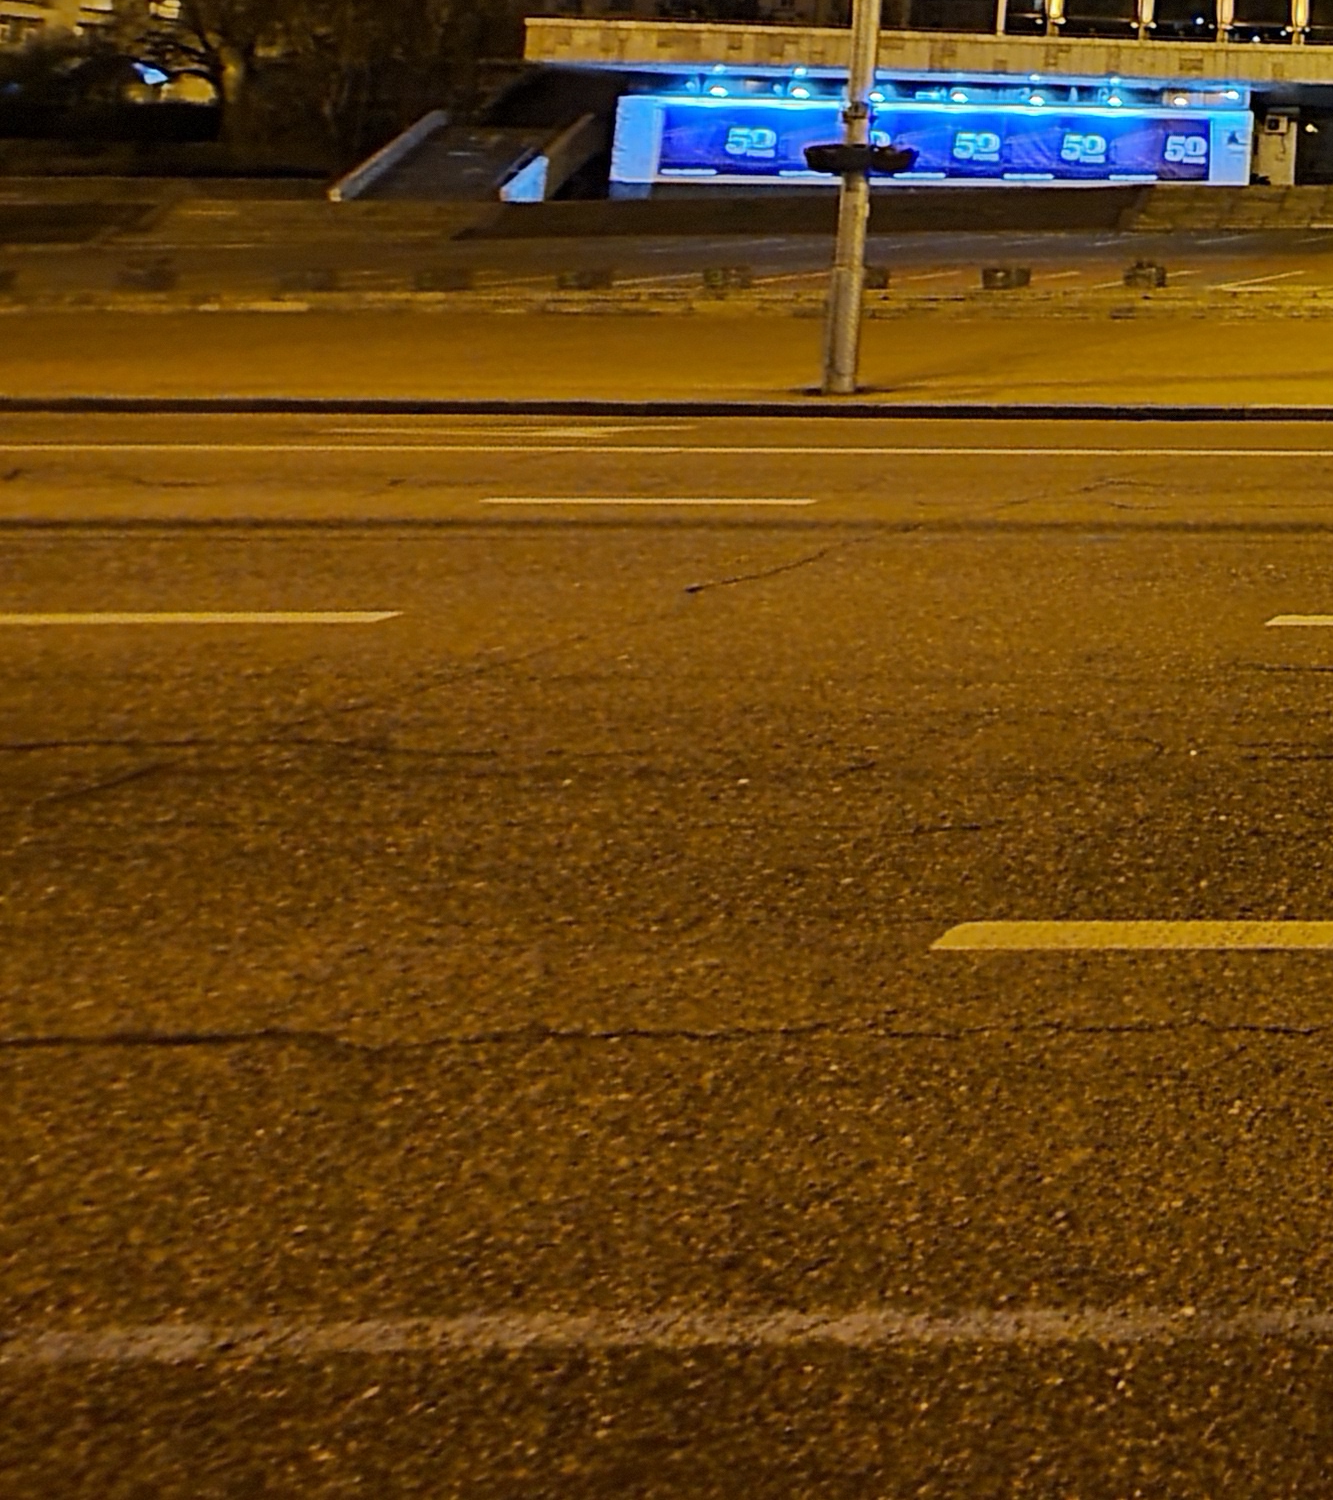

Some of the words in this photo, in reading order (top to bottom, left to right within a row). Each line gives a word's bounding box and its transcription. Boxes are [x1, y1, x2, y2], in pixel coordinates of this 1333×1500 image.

[725, 128, 776, 155] 50
[953, 132, 1000, 159] 50
[1061, 134, 1106, 161] 50
[1164, 136, 1207, 162] 50
